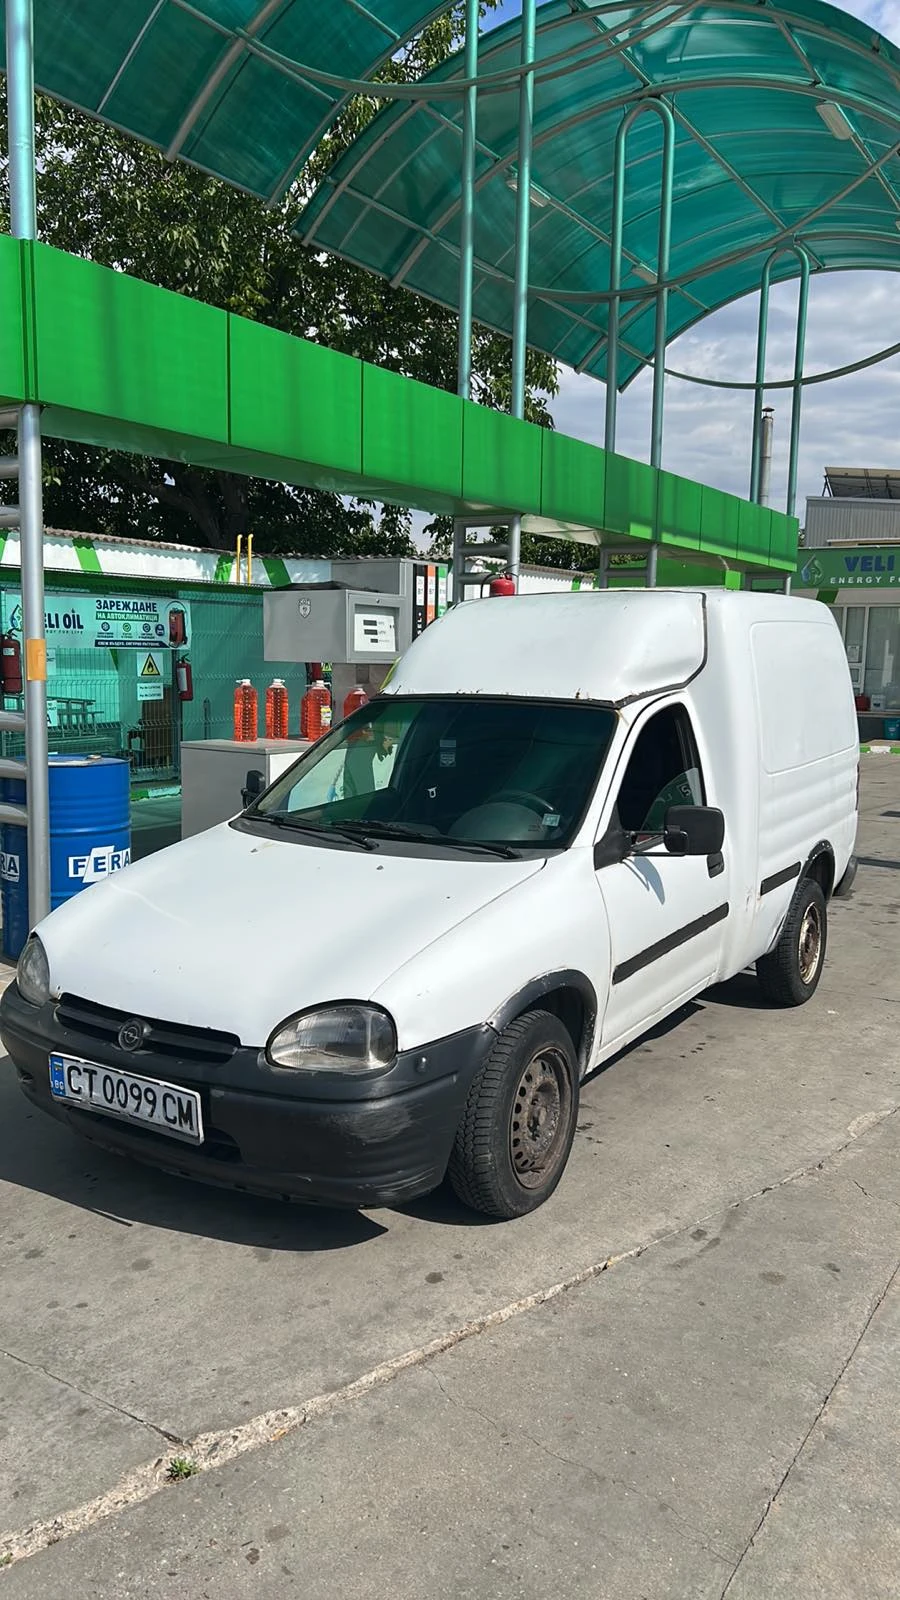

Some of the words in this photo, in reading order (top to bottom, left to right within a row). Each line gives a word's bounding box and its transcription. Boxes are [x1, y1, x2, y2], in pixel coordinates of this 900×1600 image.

[844, 555, 895, 572] VELI
[830, 576, 882, 584] ENERGY
[96, 600, 157, 613] ЗАРЕЖДАНЕ
[63, 611, 84, 630] OIL
[97, 612, 106, 620] НА
[73, 850, 131, 875] FERA
